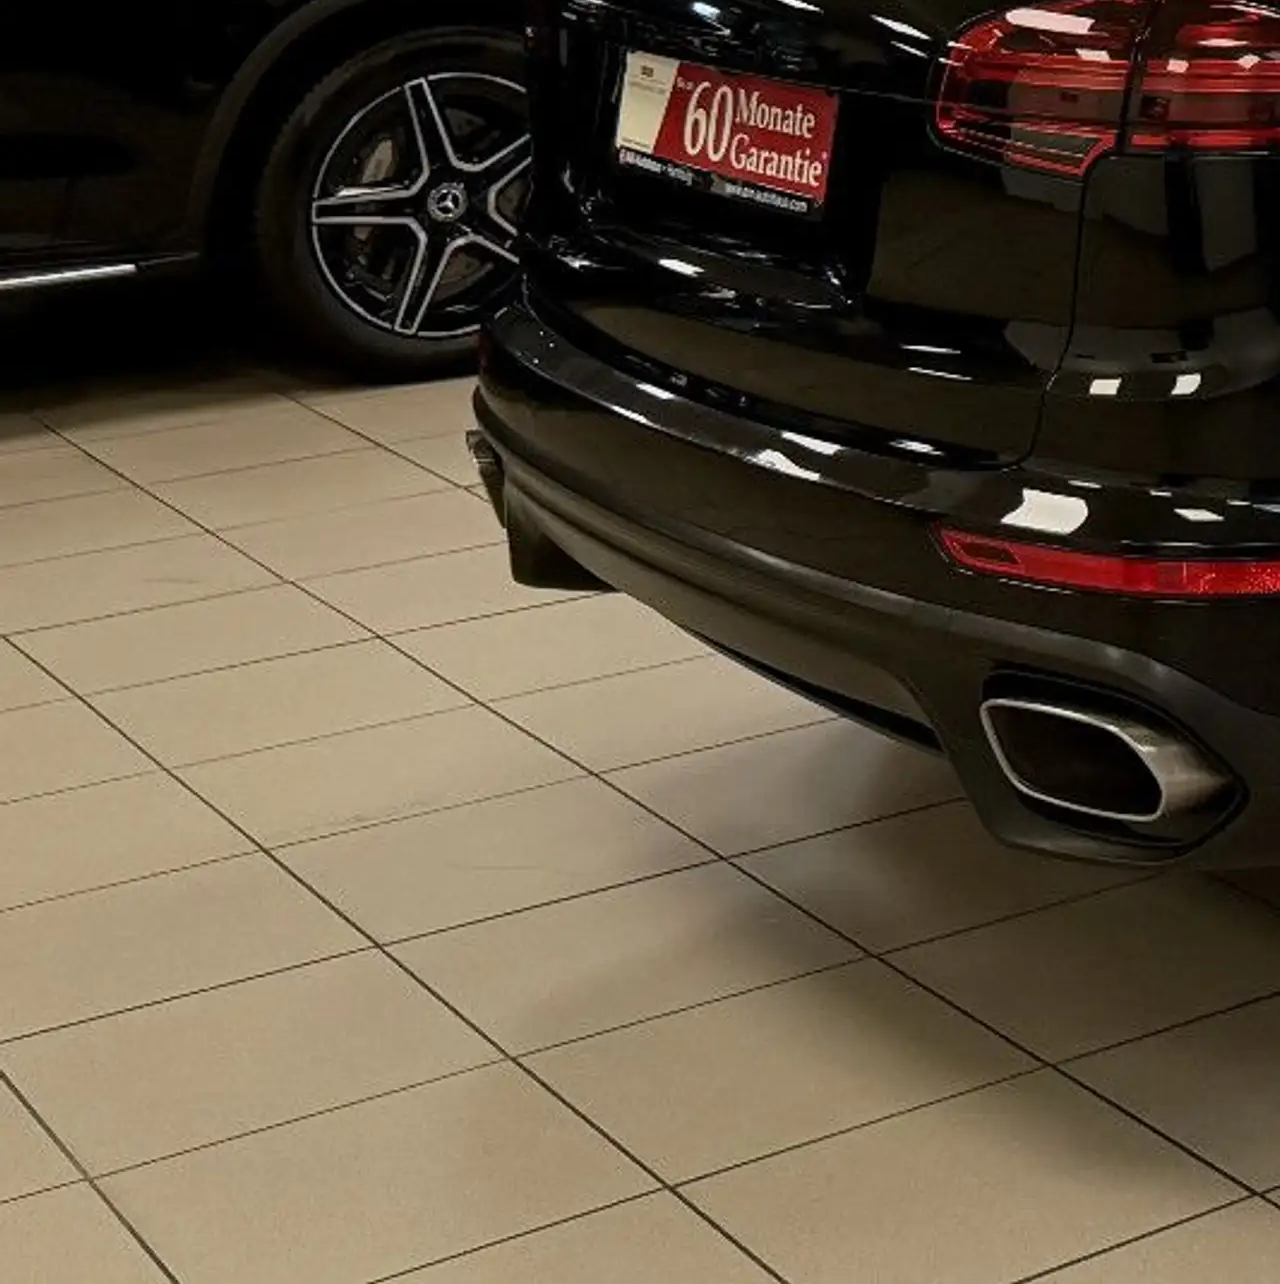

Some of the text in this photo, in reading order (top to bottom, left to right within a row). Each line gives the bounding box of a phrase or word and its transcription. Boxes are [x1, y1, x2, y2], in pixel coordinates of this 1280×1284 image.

[684, 81, 816, 162] 60 Monate
[730, 132, 823, 187] Garantie
